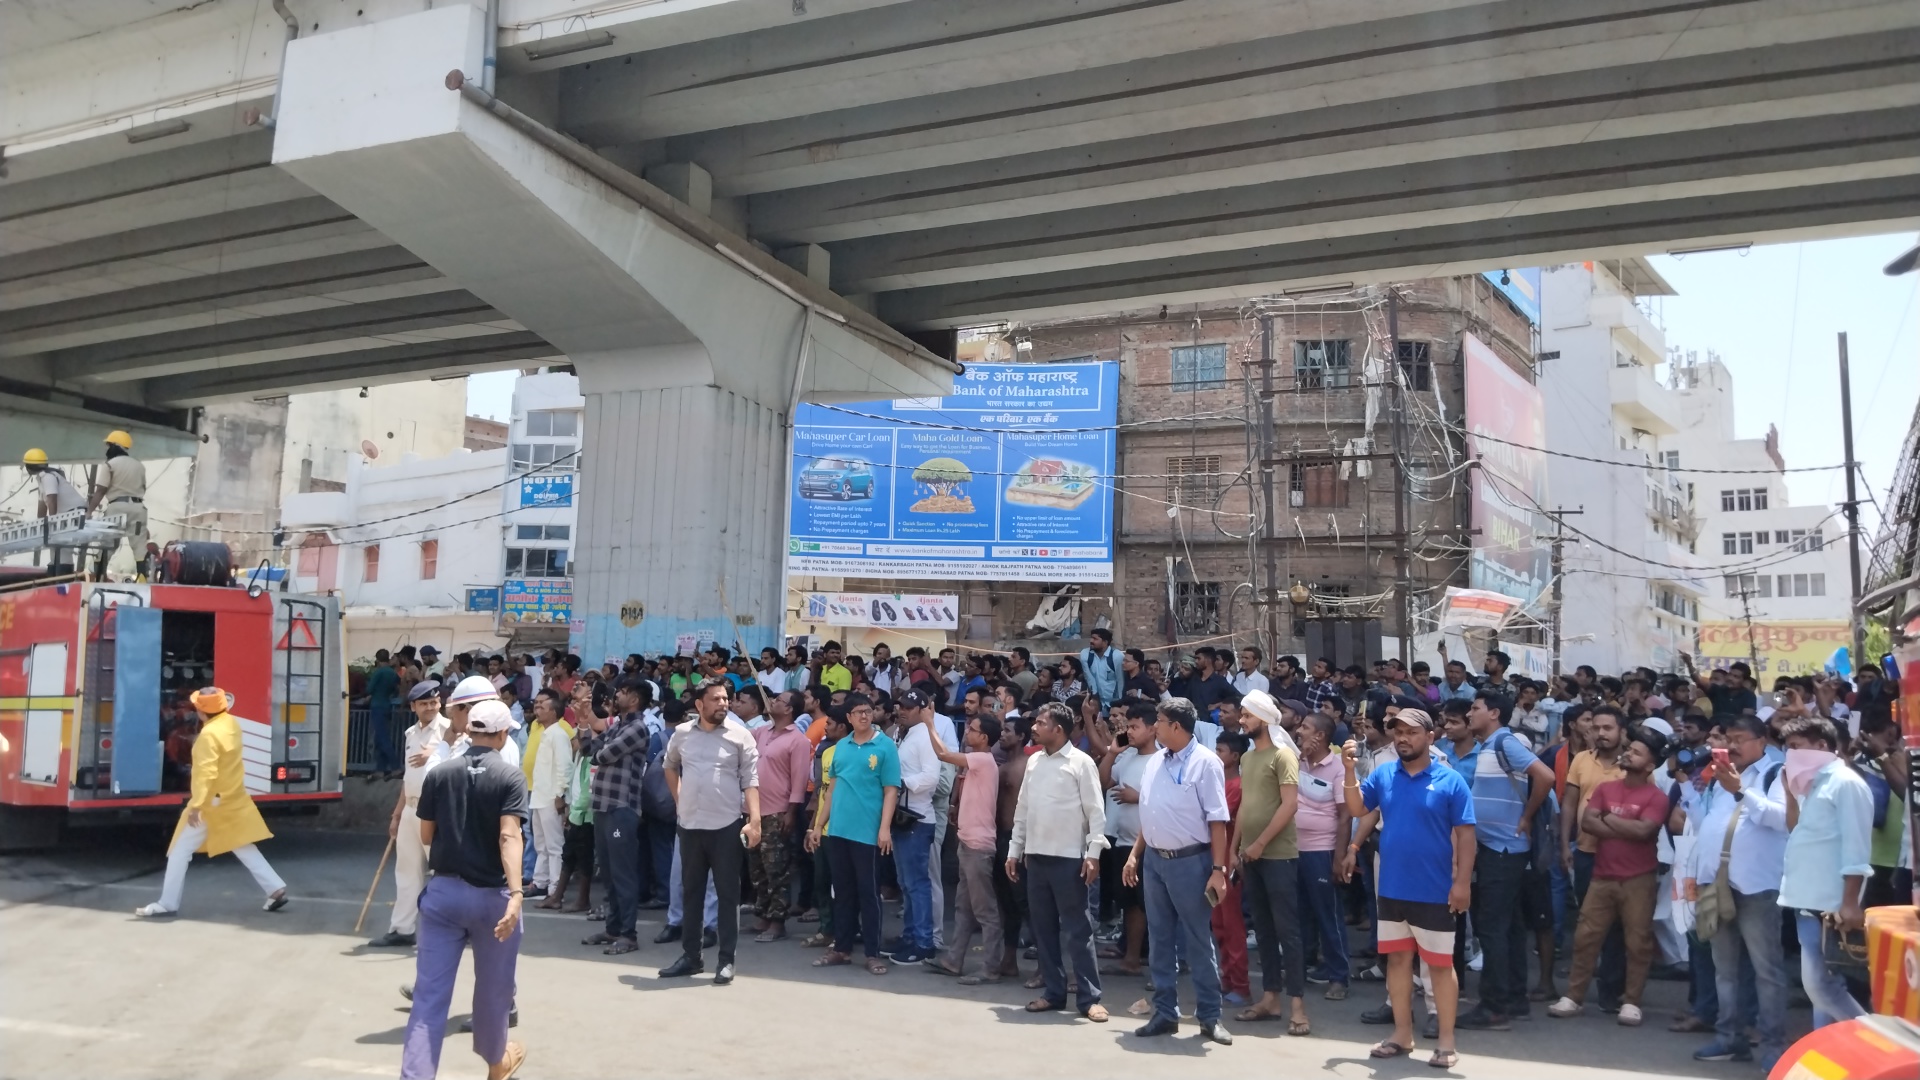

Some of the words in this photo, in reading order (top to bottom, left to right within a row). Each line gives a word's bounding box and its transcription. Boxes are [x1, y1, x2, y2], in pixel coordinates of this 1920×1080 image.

[965, 368, 990, 382] बैंक
[993, 369, 1025, 382] ऑफ
[1028, 371, 1078, 384] महाराष्ट्र
[953, 385, 986, 396] Bank
[989, 385, 1003, 396] of
[1006, 385, 1089, 397] Maharashtra
[980, 415, 995, 423] एक
[996, 413, 1023, 423] परिवार
[1026, 415, 1042, 423] एक
[1043, 413, 1059, 423] बैंक
[795, 431, 847, 442] Mahasuper
[848, 433, 866, 441] Car
[868, 433, 890, 442] Loan
[912, 434, 937, 442] Maha
[939, 434, 959, 442] Gold
[961, 434, 983, 442] Loan
[1006, 432, 1052, 441] Mahasuper
[1053, 432, 1077, 440] Home
[1078, 432, 1099, 440] Loan
[523, 476, 571, 484] HOTEL
[1492, 515, 1520, 552] BIHAR
